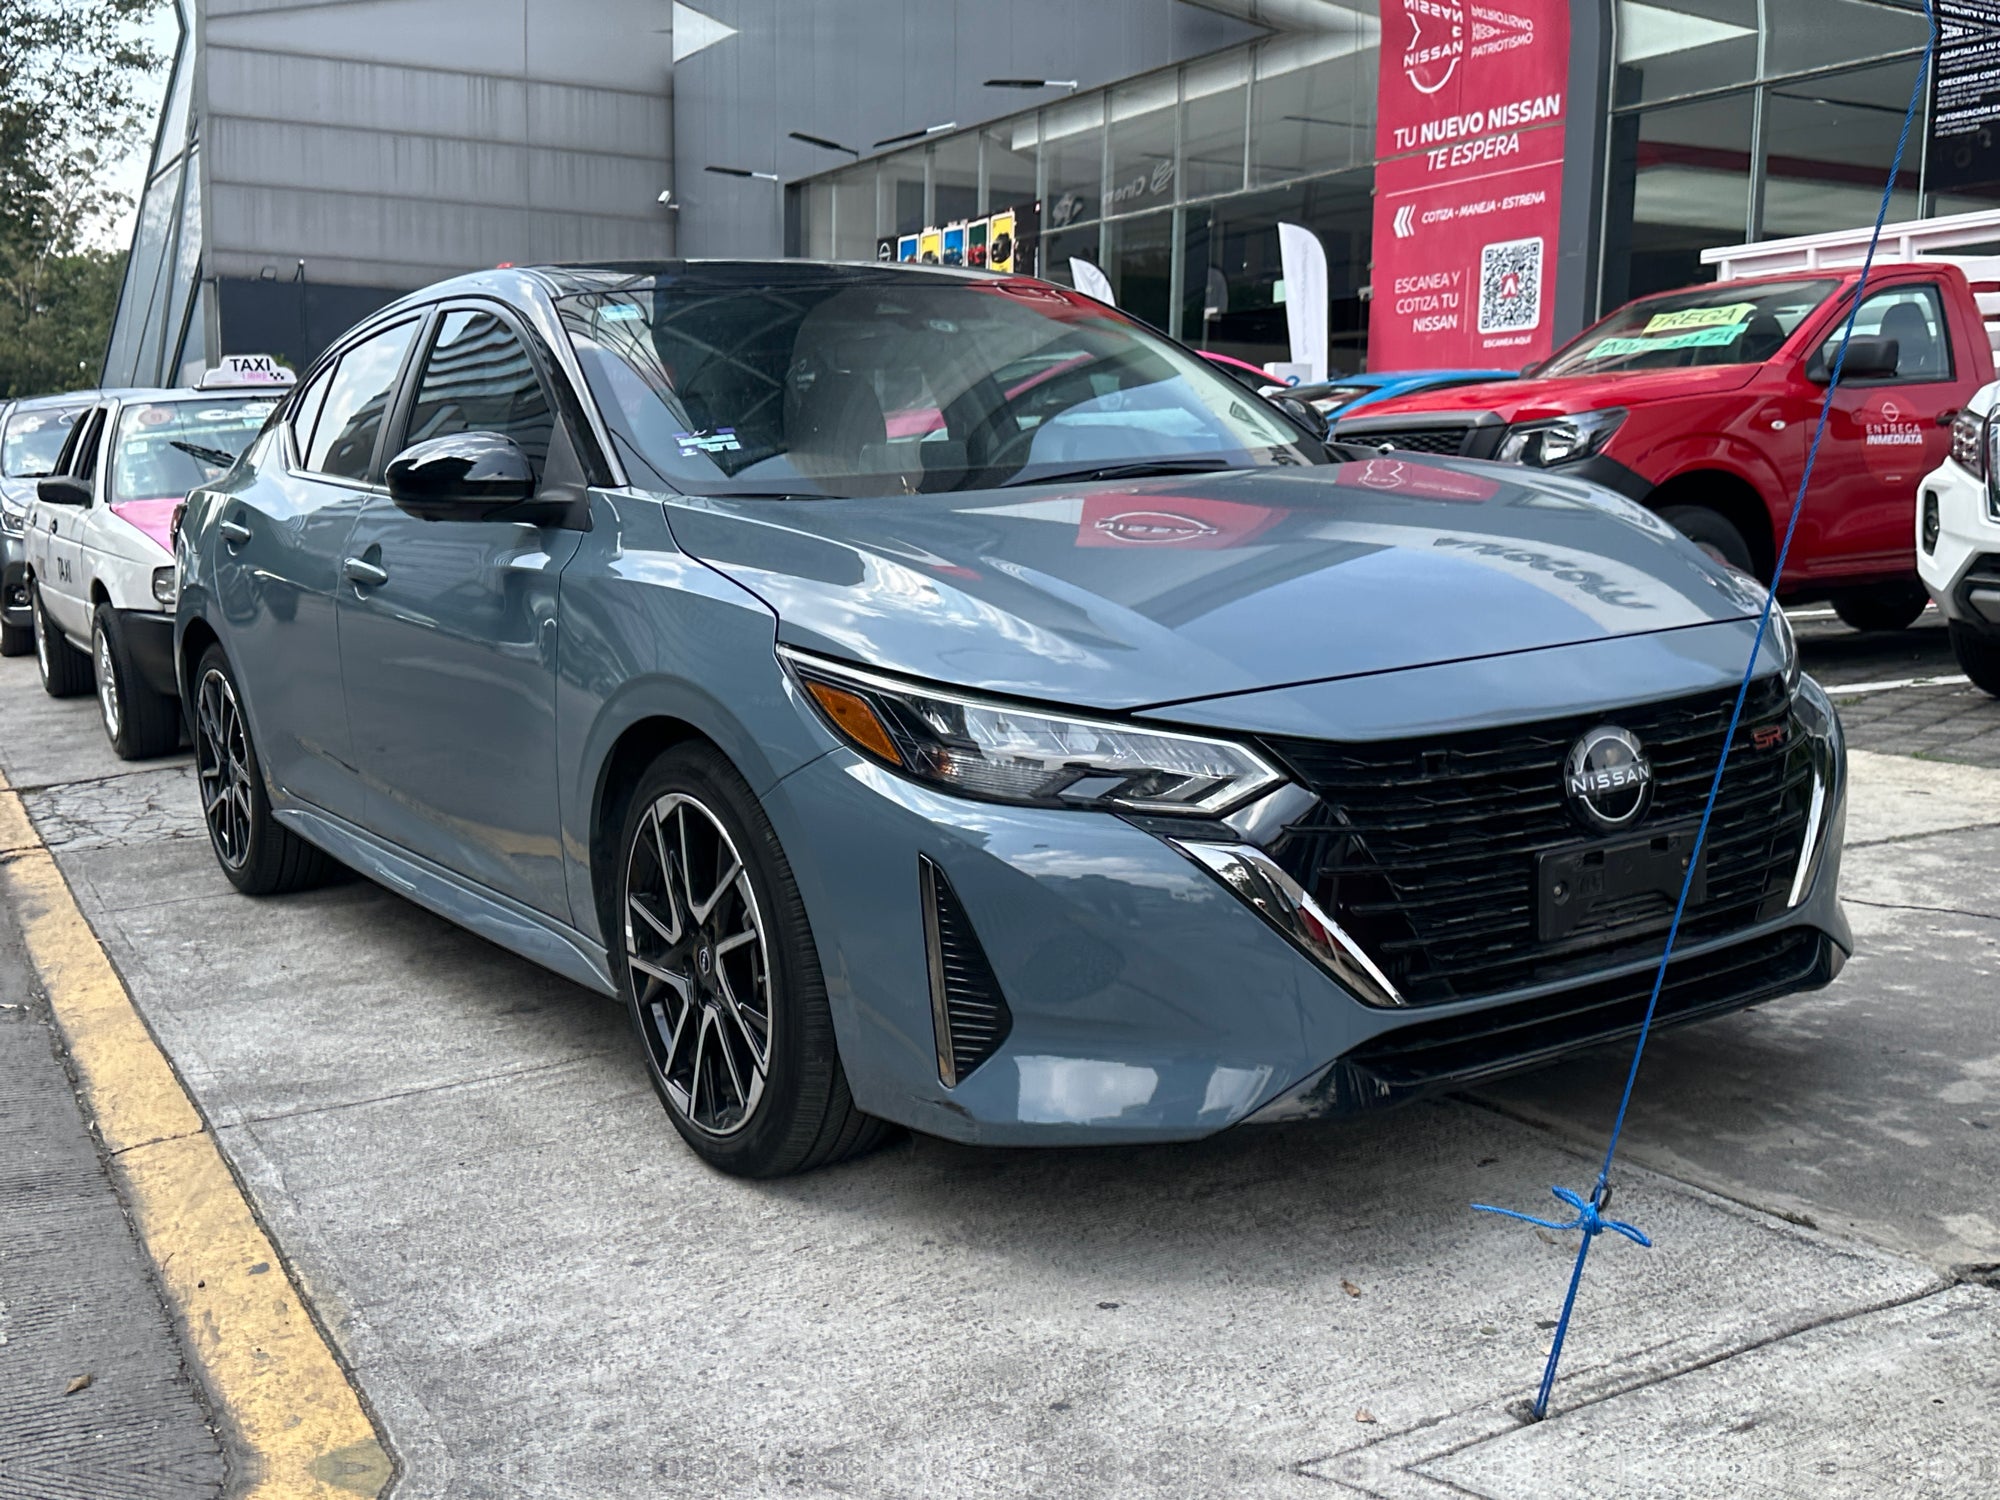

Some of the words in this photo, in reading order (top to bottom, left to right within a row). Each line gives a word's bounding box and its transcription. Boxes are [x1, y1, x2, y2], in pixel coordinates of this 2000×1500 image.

[1403, 40, 1464, 68] NISSAN
[1470, 32, 1534, 60] PATRIOTISMO
[1985, 41, 1997, 51] TU
[1938, 73, 1979, 88] CRECEMOS
[1394, 126, 1417, 149] TU
[1420, 112, 1483, 144] NUEVO
[1487, 94, 1560, 130] NISSAN
[1935, 105, 1991, 123] AUTORIZACIÓN
[1427, 148, 1447, 172] TE
[1450, 133, 1519, 167] ESPERA
[1421, 208, 1454, 224] COTIZA
[1458, 200, 1497, 218] MANEJA
[1501, 190, 1546, 210] ESTRENA
[1394, 273, 1447, 294] ESCANEA
[1448, 271, 1461, 286] Y
[1395, 298, 1439, 315] COTIZA
[1440, 292, 1460, 309] TU
[1412, 313, 1458, 333] NISSAN
[229, 358, 271, 372] TAXI
[1866, 423, 1921, 434] ENTREGA
[1866, 433, 1923, 446] INMEDIATA
[57, 556, 73, 584] TAXI
[1752, 724, 1784, 751] SR
[1571, 764, 1650, 794] NISSAN
